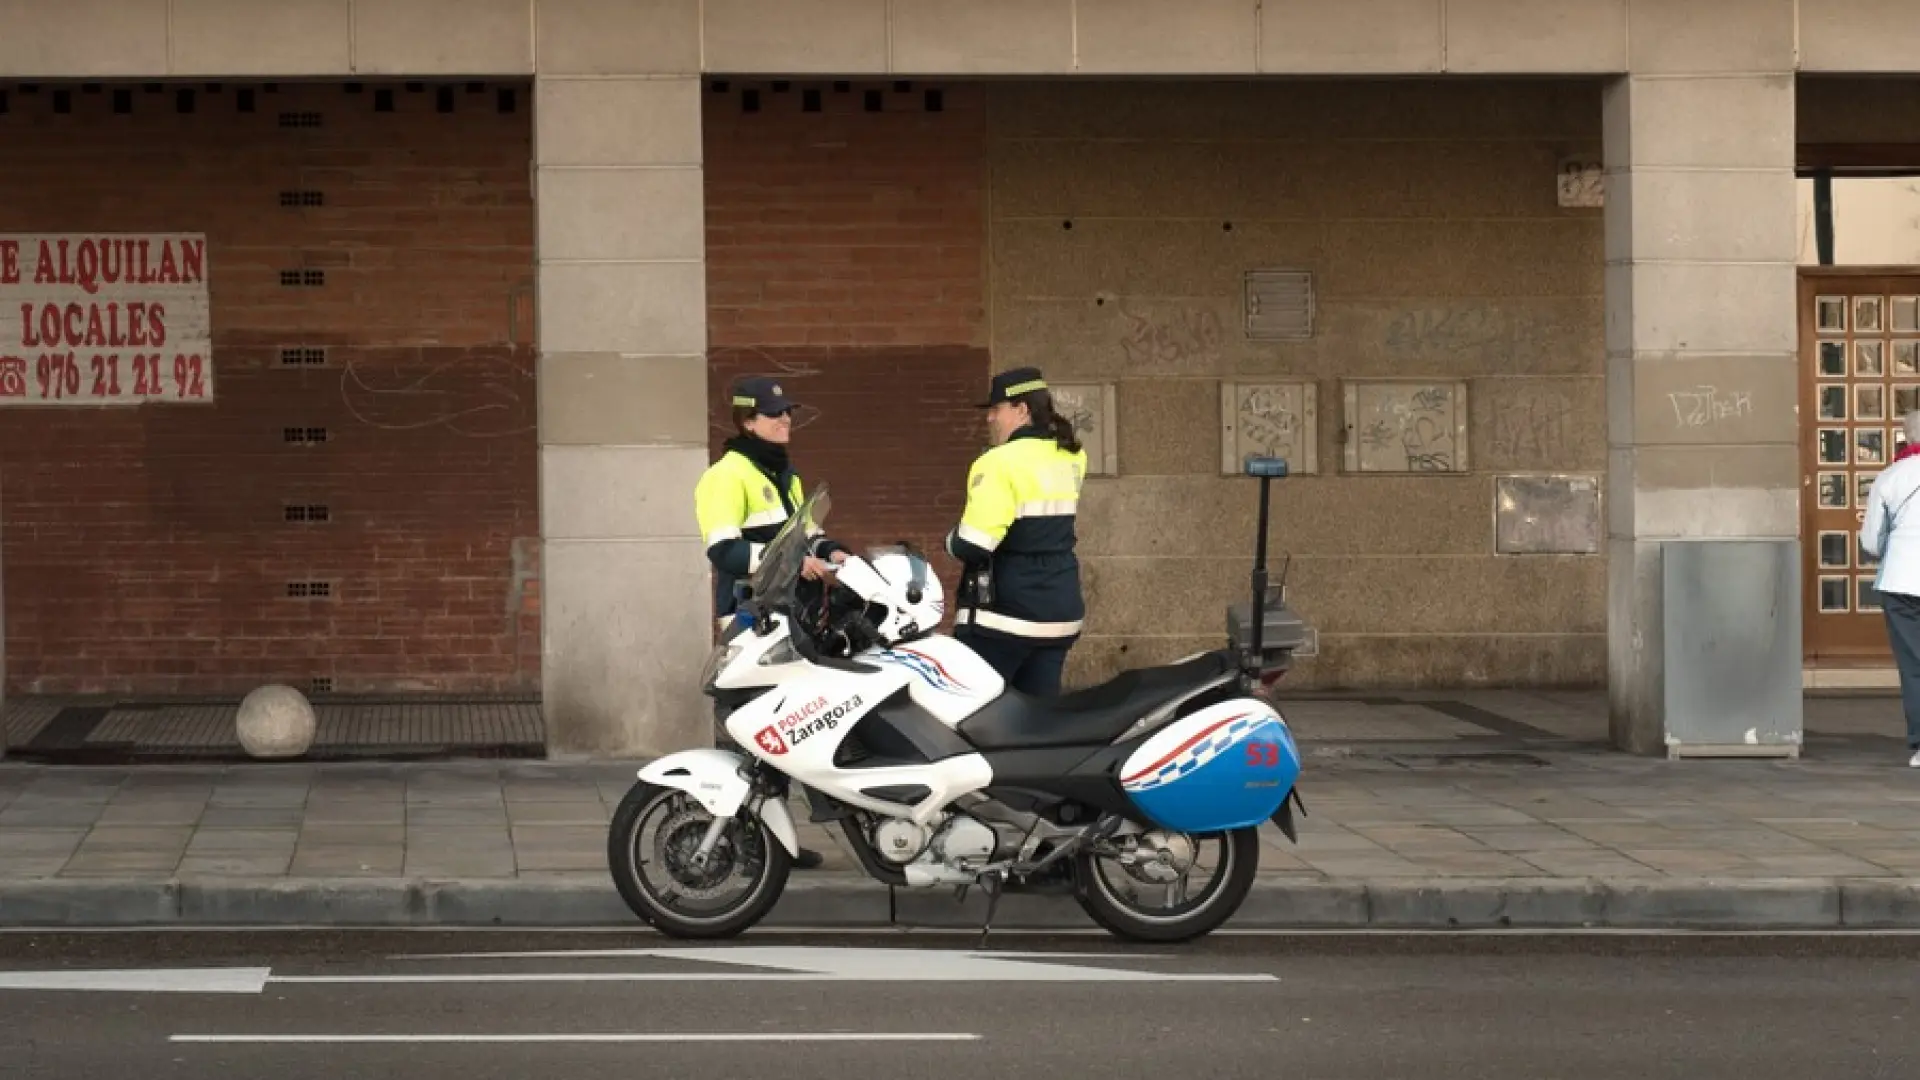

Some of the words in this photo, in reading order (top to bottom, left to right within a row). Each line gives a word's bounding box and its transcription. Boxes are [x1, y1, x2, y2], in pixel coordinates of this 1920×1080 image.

[34, 239, 204, 294] ALQUILAN
[21, 303, 167, 347] LOCALES
[36, 352, 80, 399] 976
[91, 354, 121, 397] 21
[132, 354, 163, 395] 21
[174, 354, 204, 398] 92
[786, 694, 863, 746] Zaragoza
[1246, 743, 1279, 767] 53
